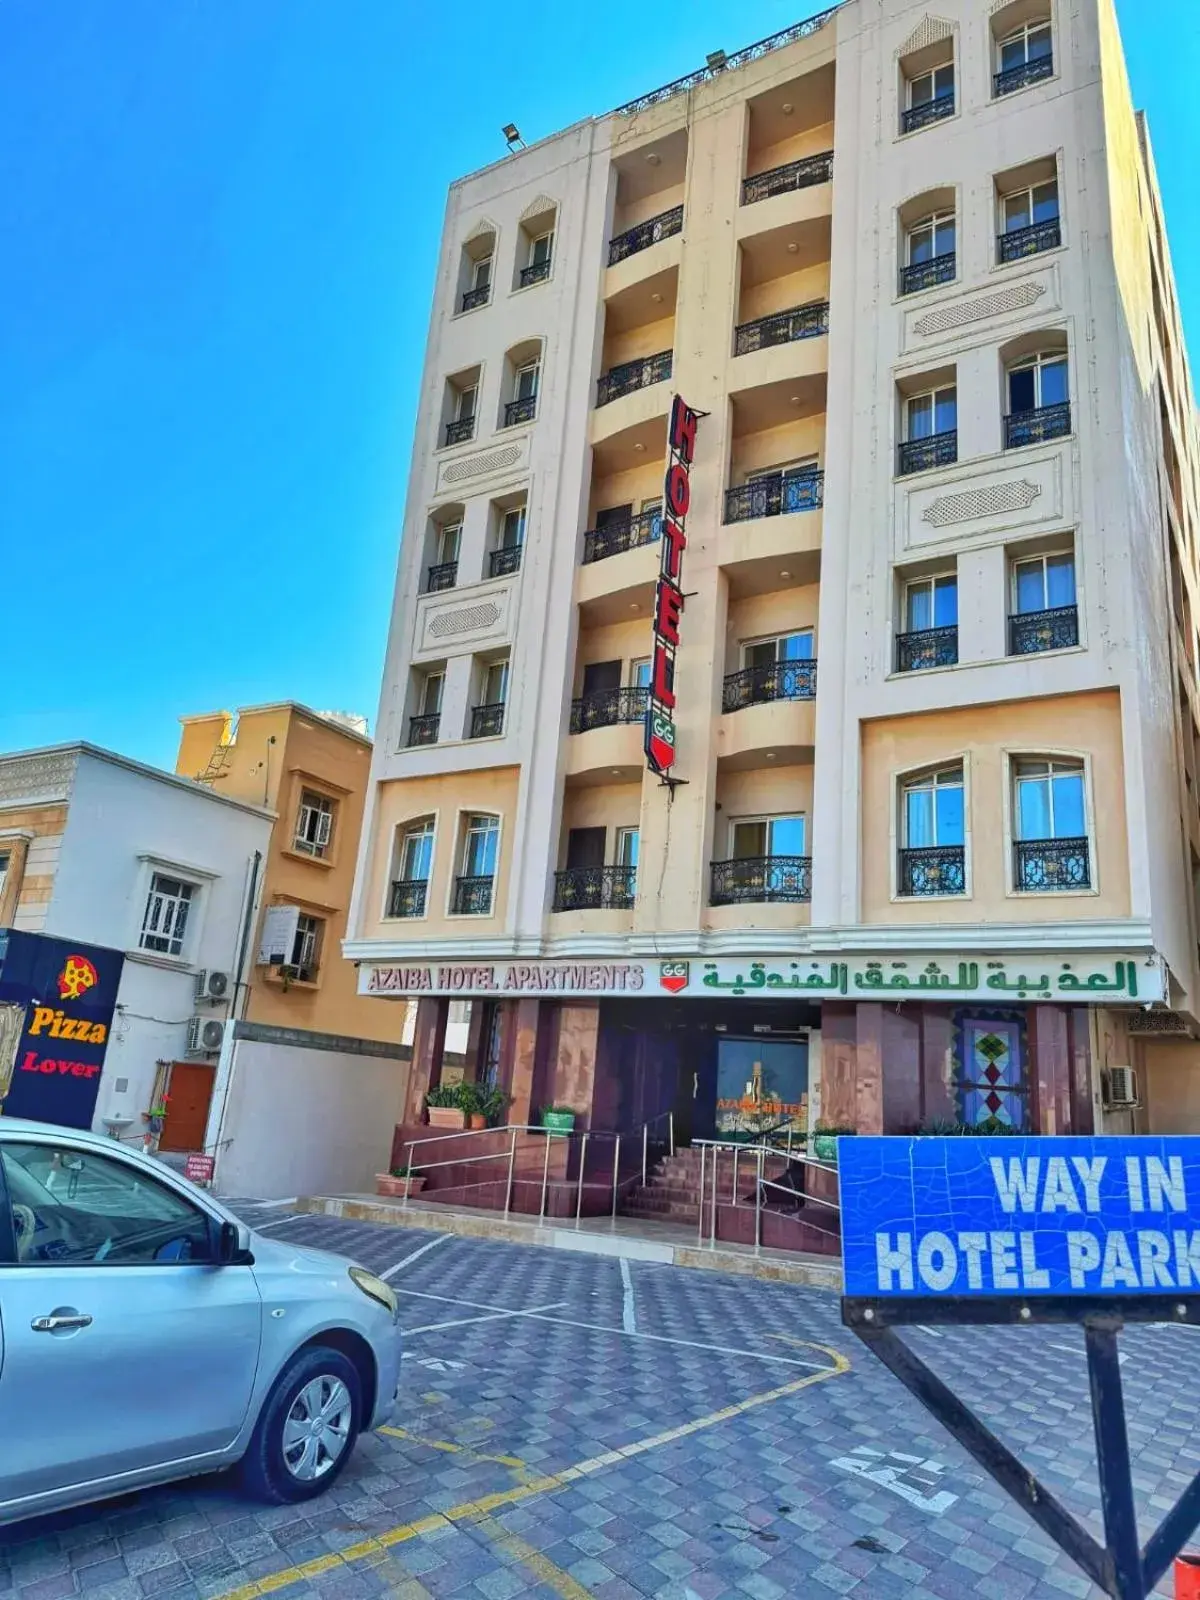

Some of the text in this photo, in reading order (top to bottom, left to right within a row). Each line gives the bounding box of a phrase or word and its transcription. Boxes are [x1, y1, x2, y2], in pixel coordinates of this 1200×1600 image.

[652, 394, 697, 709] HOTEL
[654, 718, 674, 744] GG
[367, 964, 644, 991] AZAIBA HOTEL APARTMENTS
[662, 964, 686, 977] GG
[703, 962, 848, 995] الفندقية
[854, 961, 979, 991] للشقق
[28, 1007, 107, 1044] Pizza
[21, 1051, 99, 1078] Lover
[989, 1156, 1187, 1213] WAY IN
[875, 1230, 1200, 1291] HOTEL PARK
